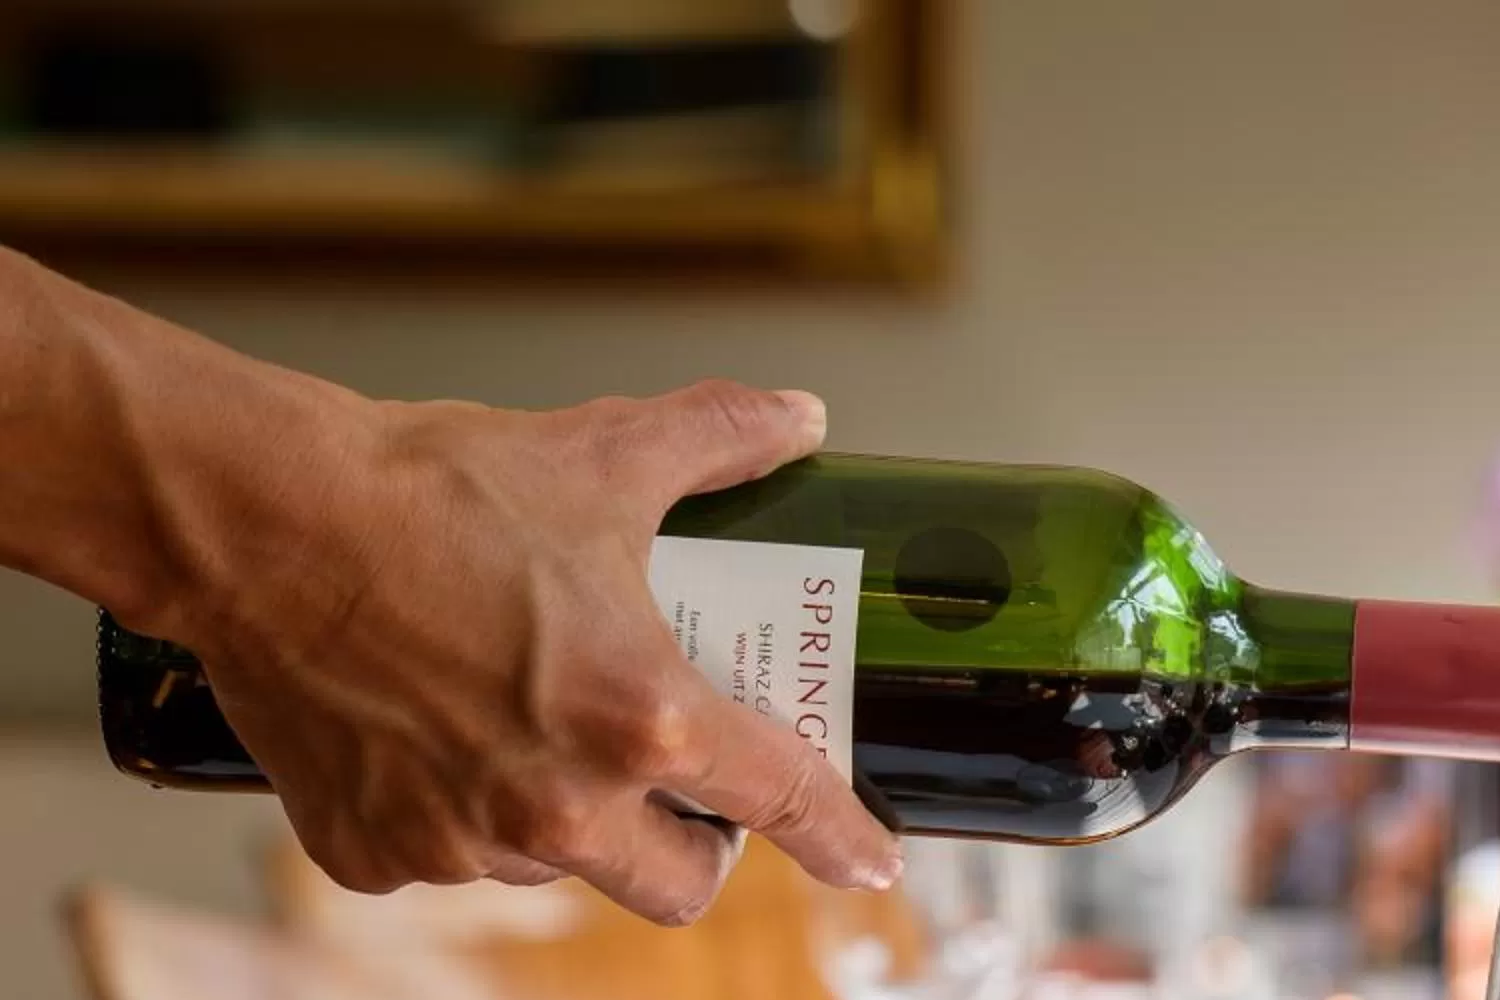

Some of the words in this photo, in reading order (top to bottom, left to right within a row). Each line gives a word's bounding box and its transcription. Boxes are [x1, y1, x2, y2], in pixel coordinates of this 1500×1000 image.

[755, 623, 773, 693] SHIRAZ
[733, 670, 745, 692] UIT
[733, 693, 745, 704] Z
